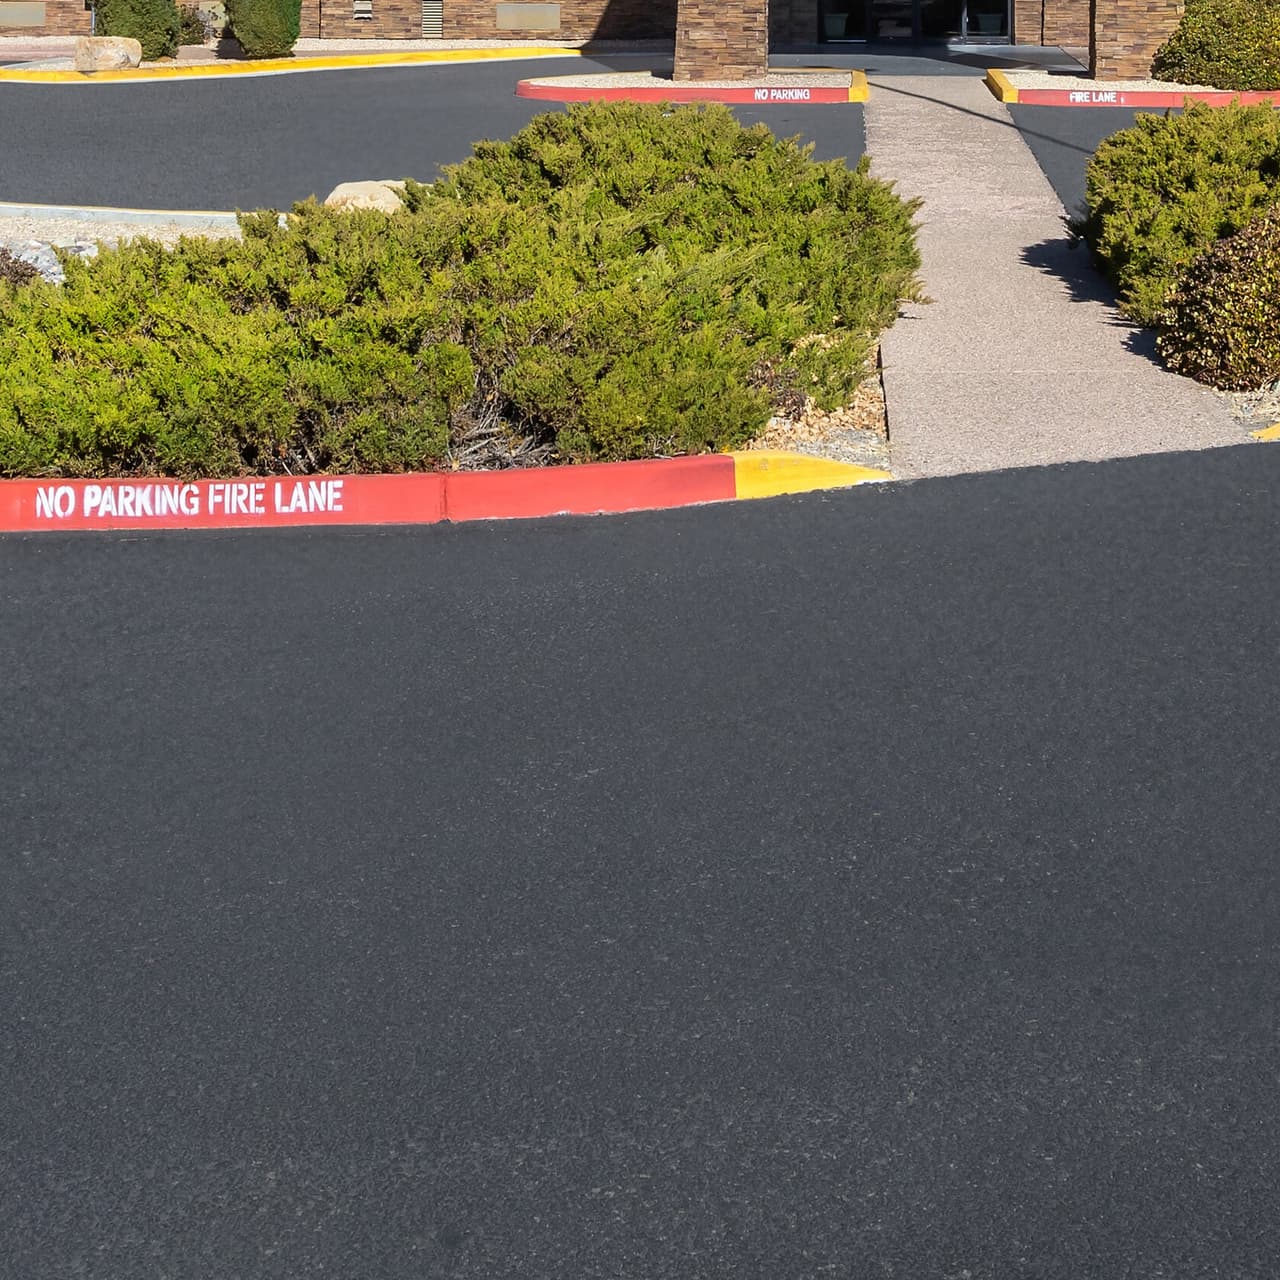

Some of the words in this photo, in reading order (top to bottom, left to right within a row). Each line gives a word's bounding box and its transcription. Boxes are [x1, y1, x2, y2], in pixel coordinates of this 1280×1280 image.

[754, 89, 768, 100] NO
[770, 89, 810, 100] PARKING
[1070, 91, 1090, 102] FIRE
[1092, 91, 1117, 102] LANE
[36, 486, 75, 518] NO
[83, 484, 200, 517] PARKING
[209, 483, 265, 514] FIRE
[275, 480, 343, 513] LANE
